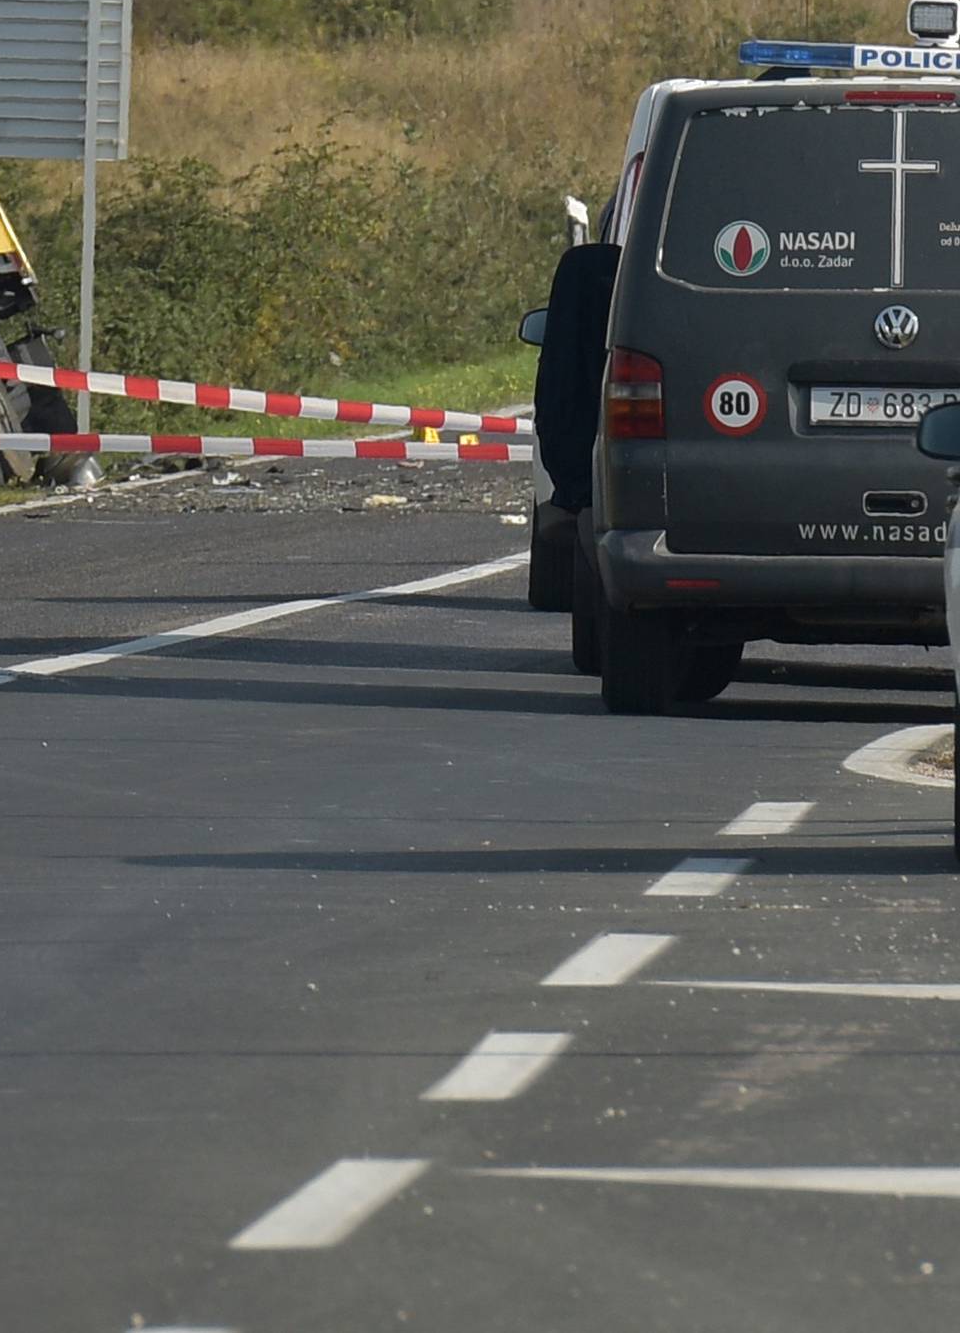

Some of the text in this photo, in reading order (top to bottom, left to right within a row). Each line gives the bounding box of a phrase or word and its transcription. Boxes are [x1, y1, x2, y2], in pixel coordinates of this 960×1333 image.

[861, 49, 960, 70] POLIC
[780, 231, 855, 250] NASADI
[780, 254, 855, 268] d.o.o. Zadar
[720, 391, 750, 416] 80
[830, 392, 861, 417] ZD
